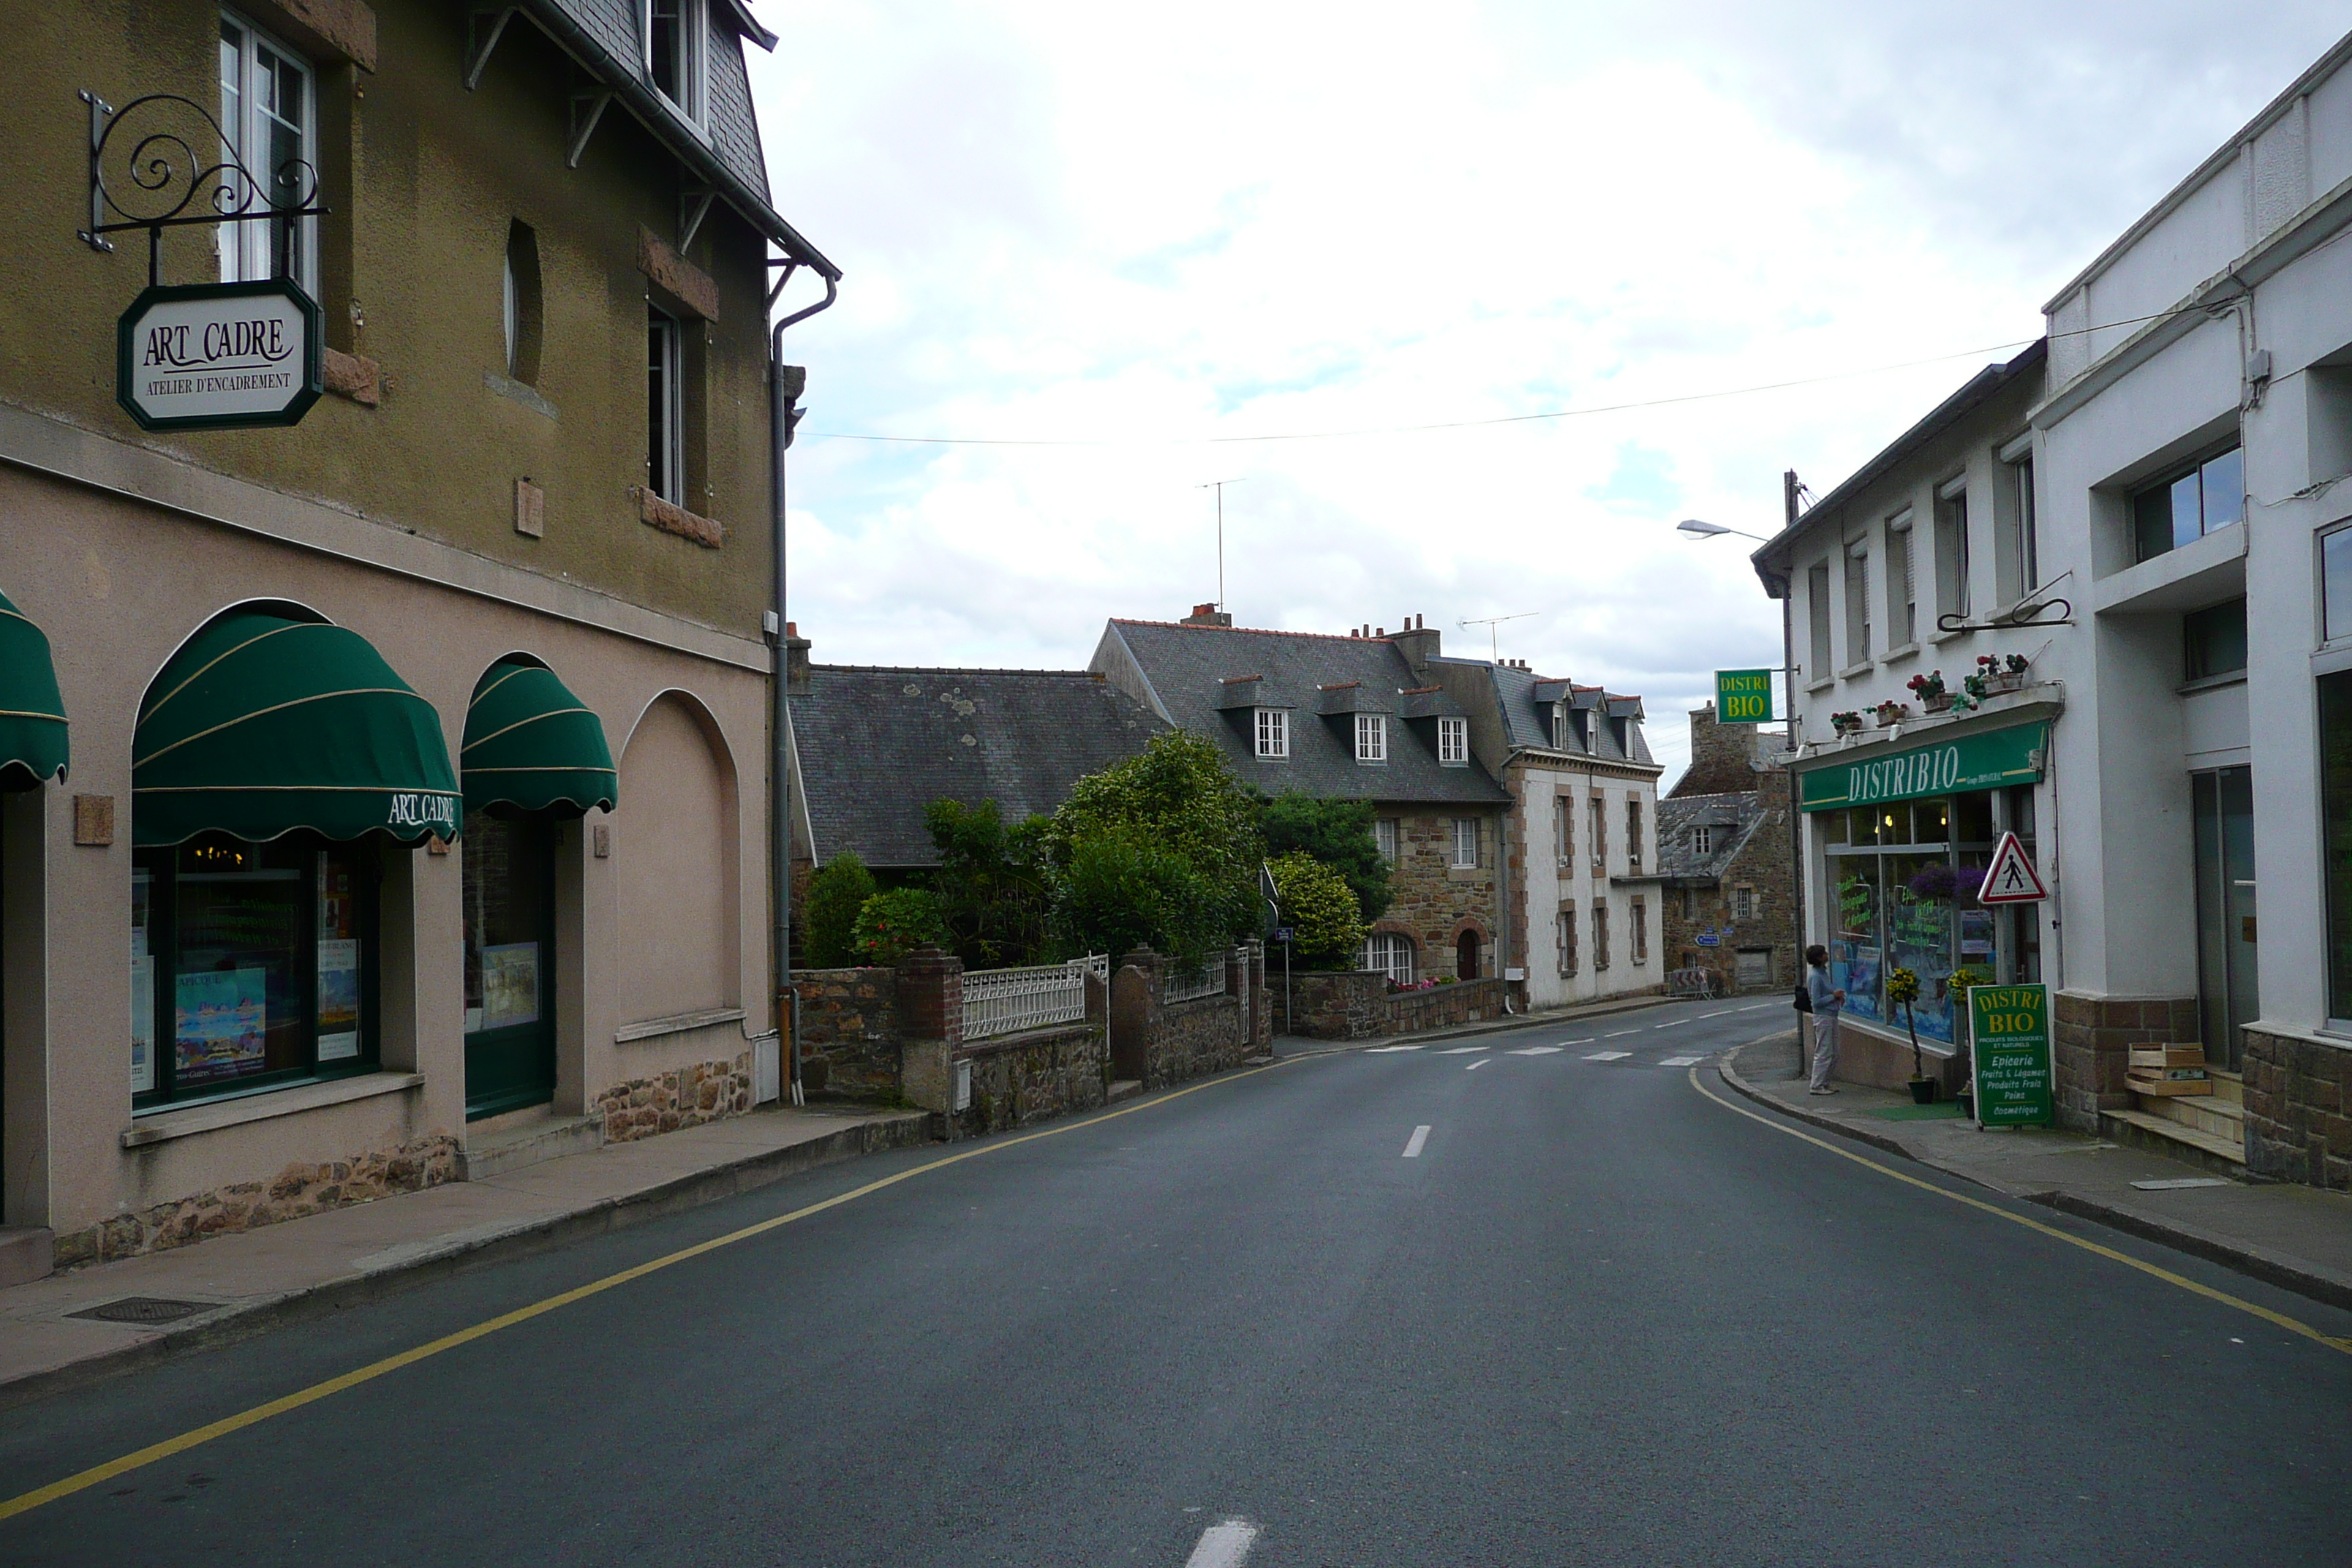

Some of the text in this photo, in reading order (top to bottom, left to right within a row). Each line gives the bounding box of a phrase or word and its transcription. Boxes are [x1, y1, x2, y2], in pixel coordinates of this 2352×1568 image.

[143, 319, 295, 366] ART CADRE
[146, 373, 291, 397] ATELIER D'ENCADREMENT
[1721, 676, 1768, 692] DISTRI
[1727, 695, 1765, 717] BIO
[1849, 746, 1959, 802] DISTRIBIO
[388, 794, 453, 828] ART CADRE
[1978, 990, 2041, 1012] DISTRI
[1988, 1012, 2035, 1033] BIO
[1991, 1055, 2033, 1068] Epicerie
[1981, 1068, 2046, 1079] Fruits & Légumes
[1986, 1079, 2041, 1090] Produits Frais
[2004, 1090, 2025, 1100] Pains
[1994, 1105, 2038, 1116] Cosmétique
